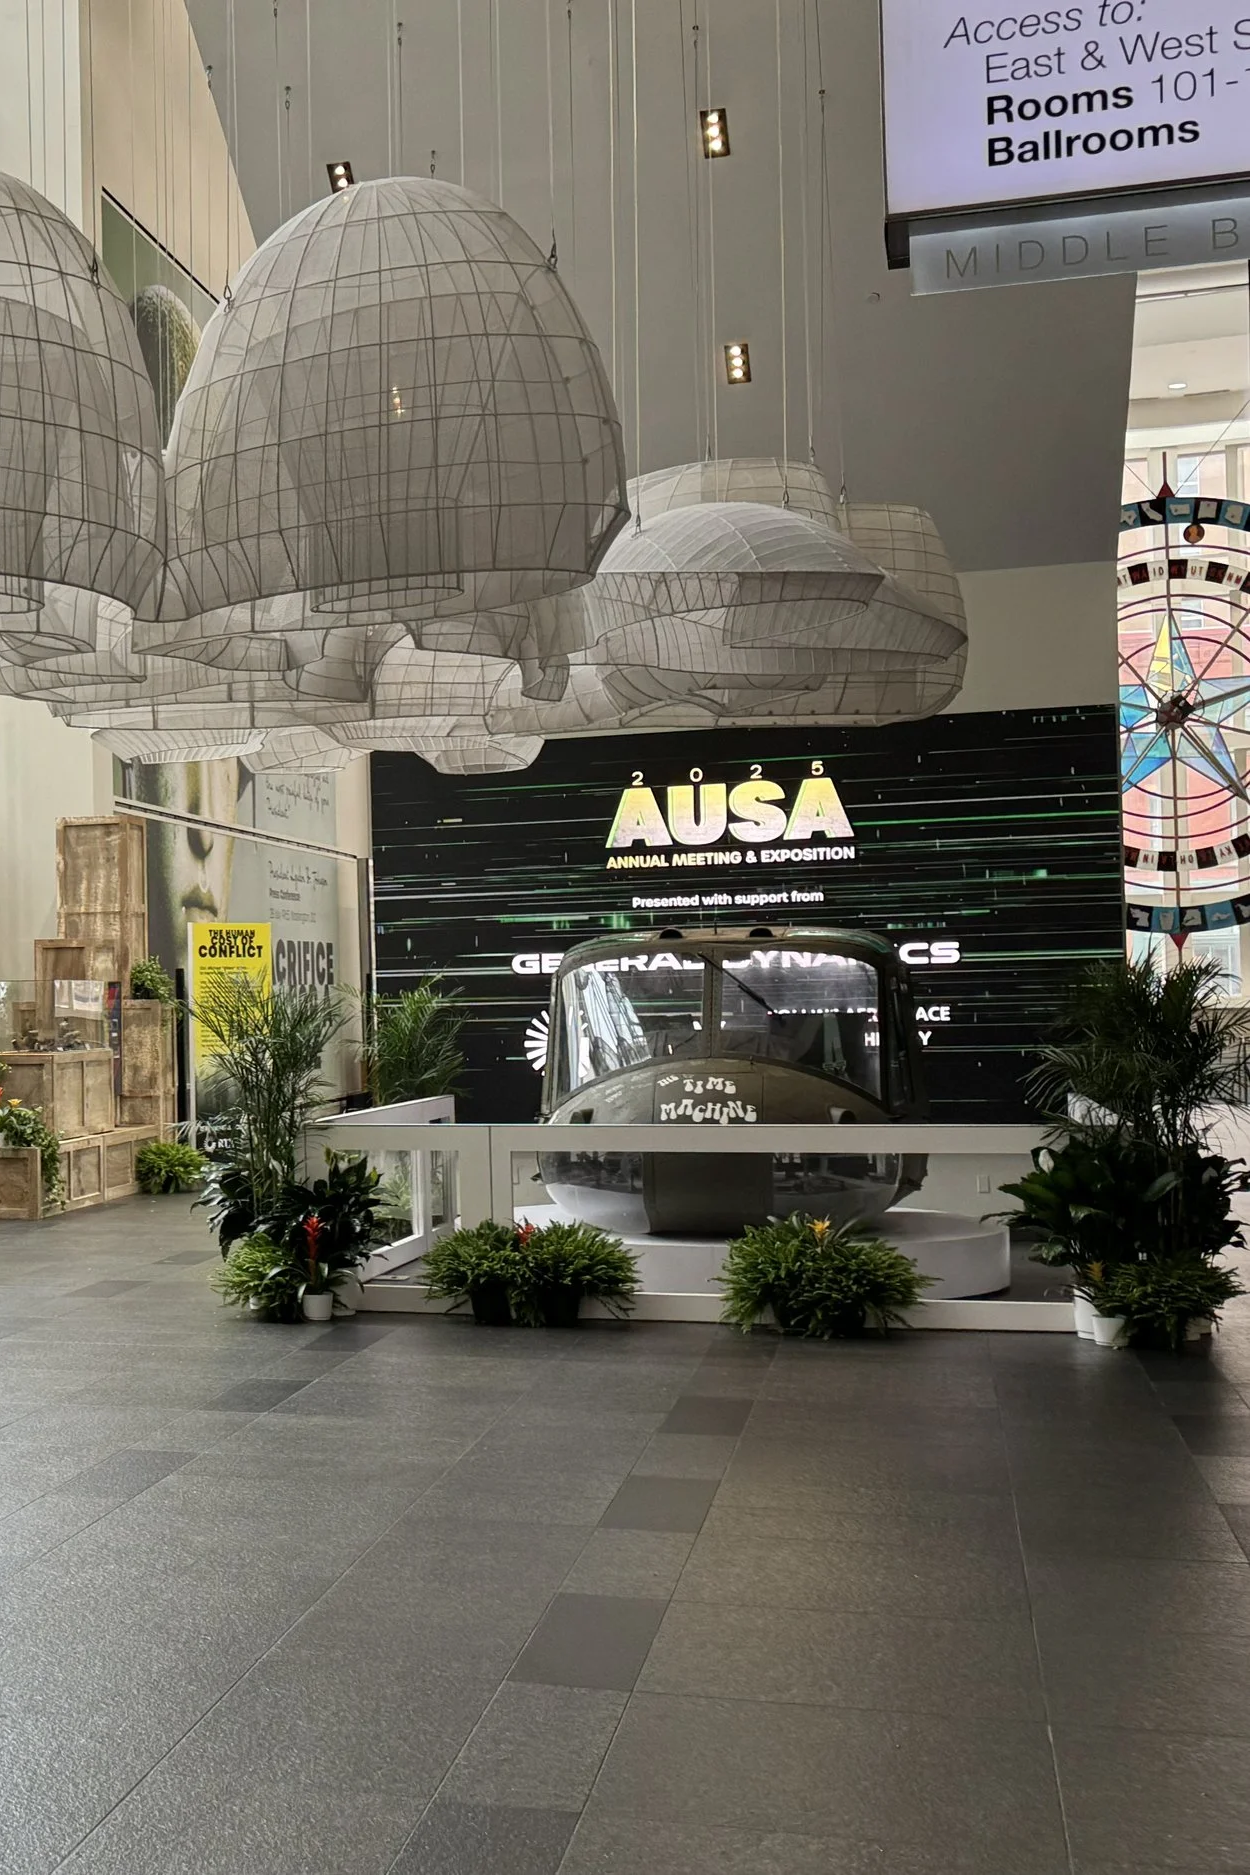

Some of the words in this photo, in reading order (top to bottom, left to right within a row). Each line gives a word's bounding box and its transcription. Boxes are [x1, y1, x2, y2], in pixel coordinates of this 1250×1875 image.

[943, 6, 1083, 49] Access
[1097, 0, 1146, 27] to:
[985, 47, 1067, 84] East
[1080, 40, 1107, 71] &
[1119, 25, 1219, 67] West
[986, 85, 1135, 126] Rooms
[1151, 67, 1250, 104] 101-
[987, 118, 1201, 168] Ballrooms
[945, 224, 1169, 281] MIDDLE
[1152, 566, 1165, 577] ID
[1190, 565, 1205, 576] UT
[605, 777, 855, 849] AUSA
[606, 854, 669, 870] ANNUAL
[672, 850, 742, 867] MEETING
[745, 851, 758, 864] &
[760, 846, 856, 864] EXPOSITION
[631, 894, 699, 909] Presented
[701, 892, 733, 906] with
[734, 891, 789, 908] support
[790, 890, 825, 904] from
[208, 929, 219, 938] THE
[225, 929, 255, 938] HUMAN
[210, 936, 238, 946] COST
[241, 936, 254, 946] OF
[198, 945, 264, 958] CONFLICT
[683, 1076, 737, 1095] TIME
[660, 1098, 758, 1125] MACHINE
